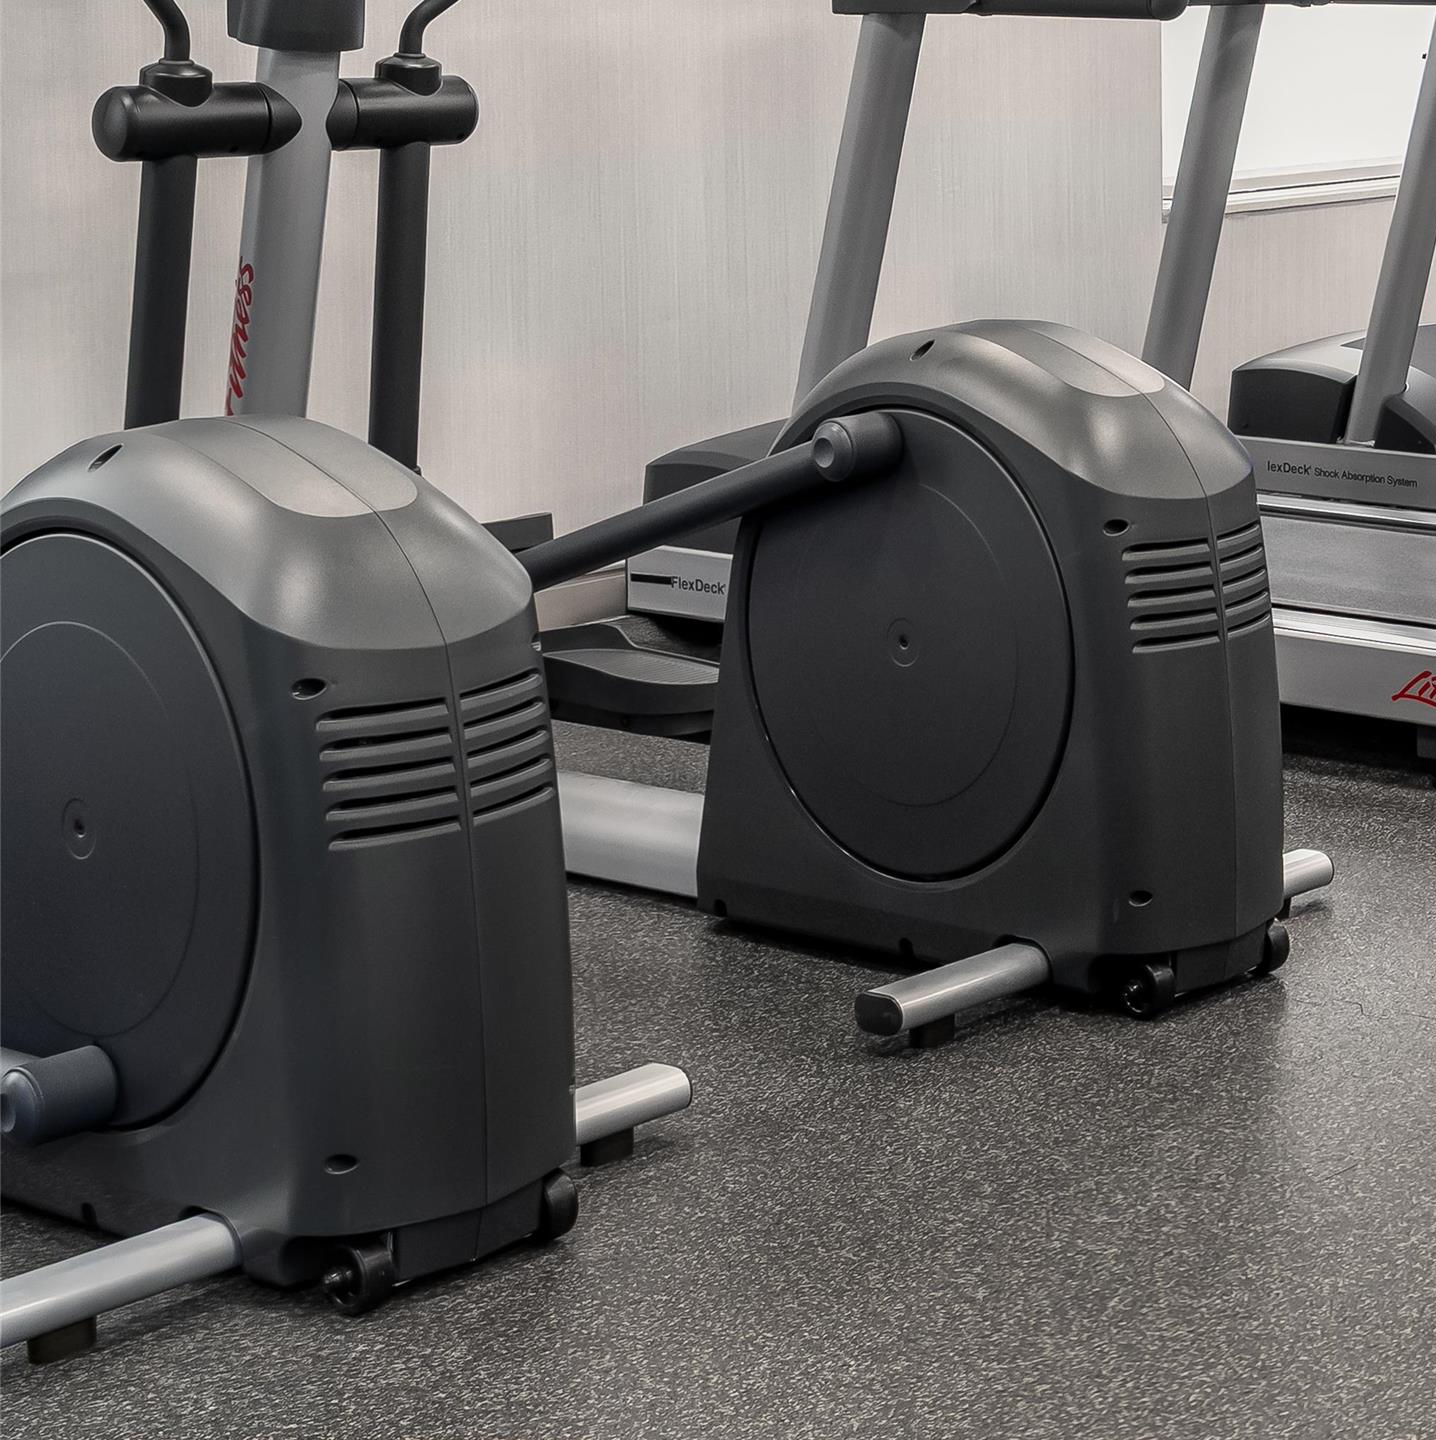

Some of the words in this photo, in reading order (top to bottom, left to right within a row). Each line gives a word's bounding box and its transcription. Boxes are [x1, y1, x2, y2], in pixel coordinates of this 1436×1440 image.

[1314, 468, 1339, 479] Shock
[1341, 470, 1385, 484] Absorption
[1387, 475, 1418, 488] System
[671, 575, 726, 595] FlexDeck
